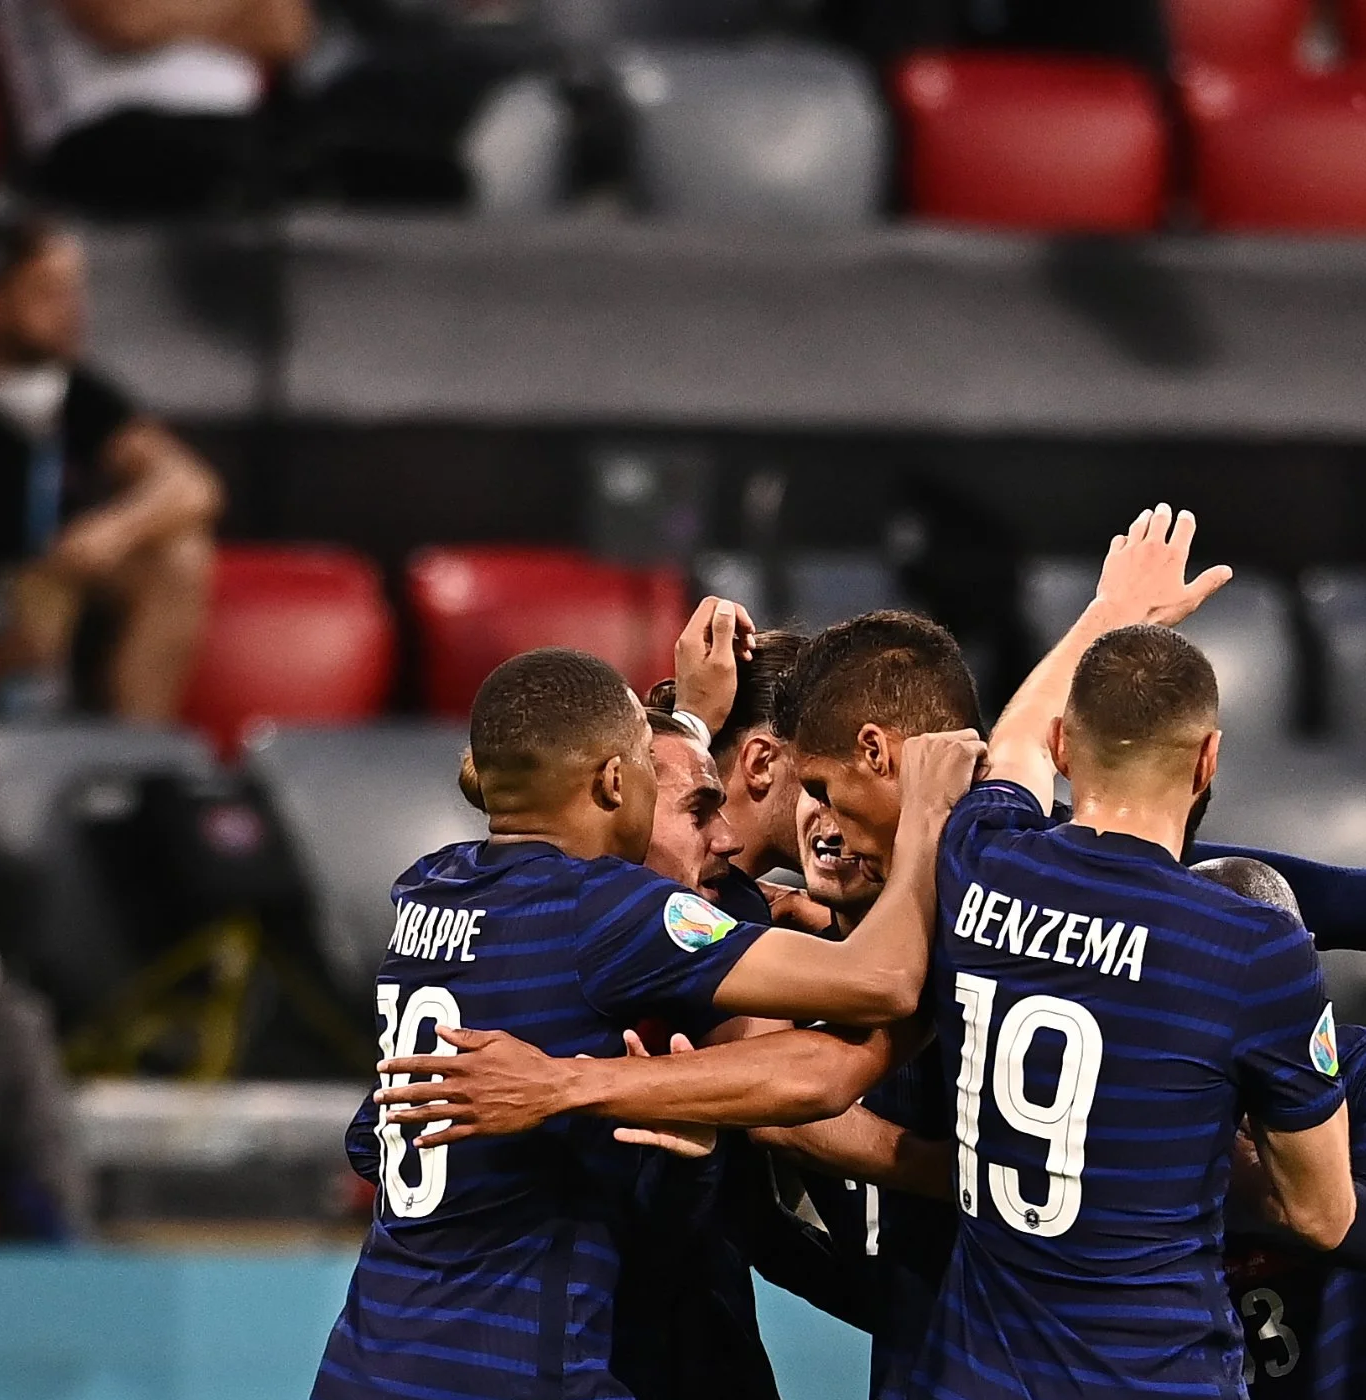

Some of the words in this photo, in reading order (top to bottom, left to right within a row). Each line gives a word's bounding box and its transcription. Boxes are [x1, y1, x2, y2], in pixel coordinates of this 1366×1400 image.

[387, 897, 487, 962] MBAPPE
[954, 882, 1149, 982] BENZEMA
[955, 972, 1103, 1238] 19
[1241, 1287, 1300, 1385] 3
